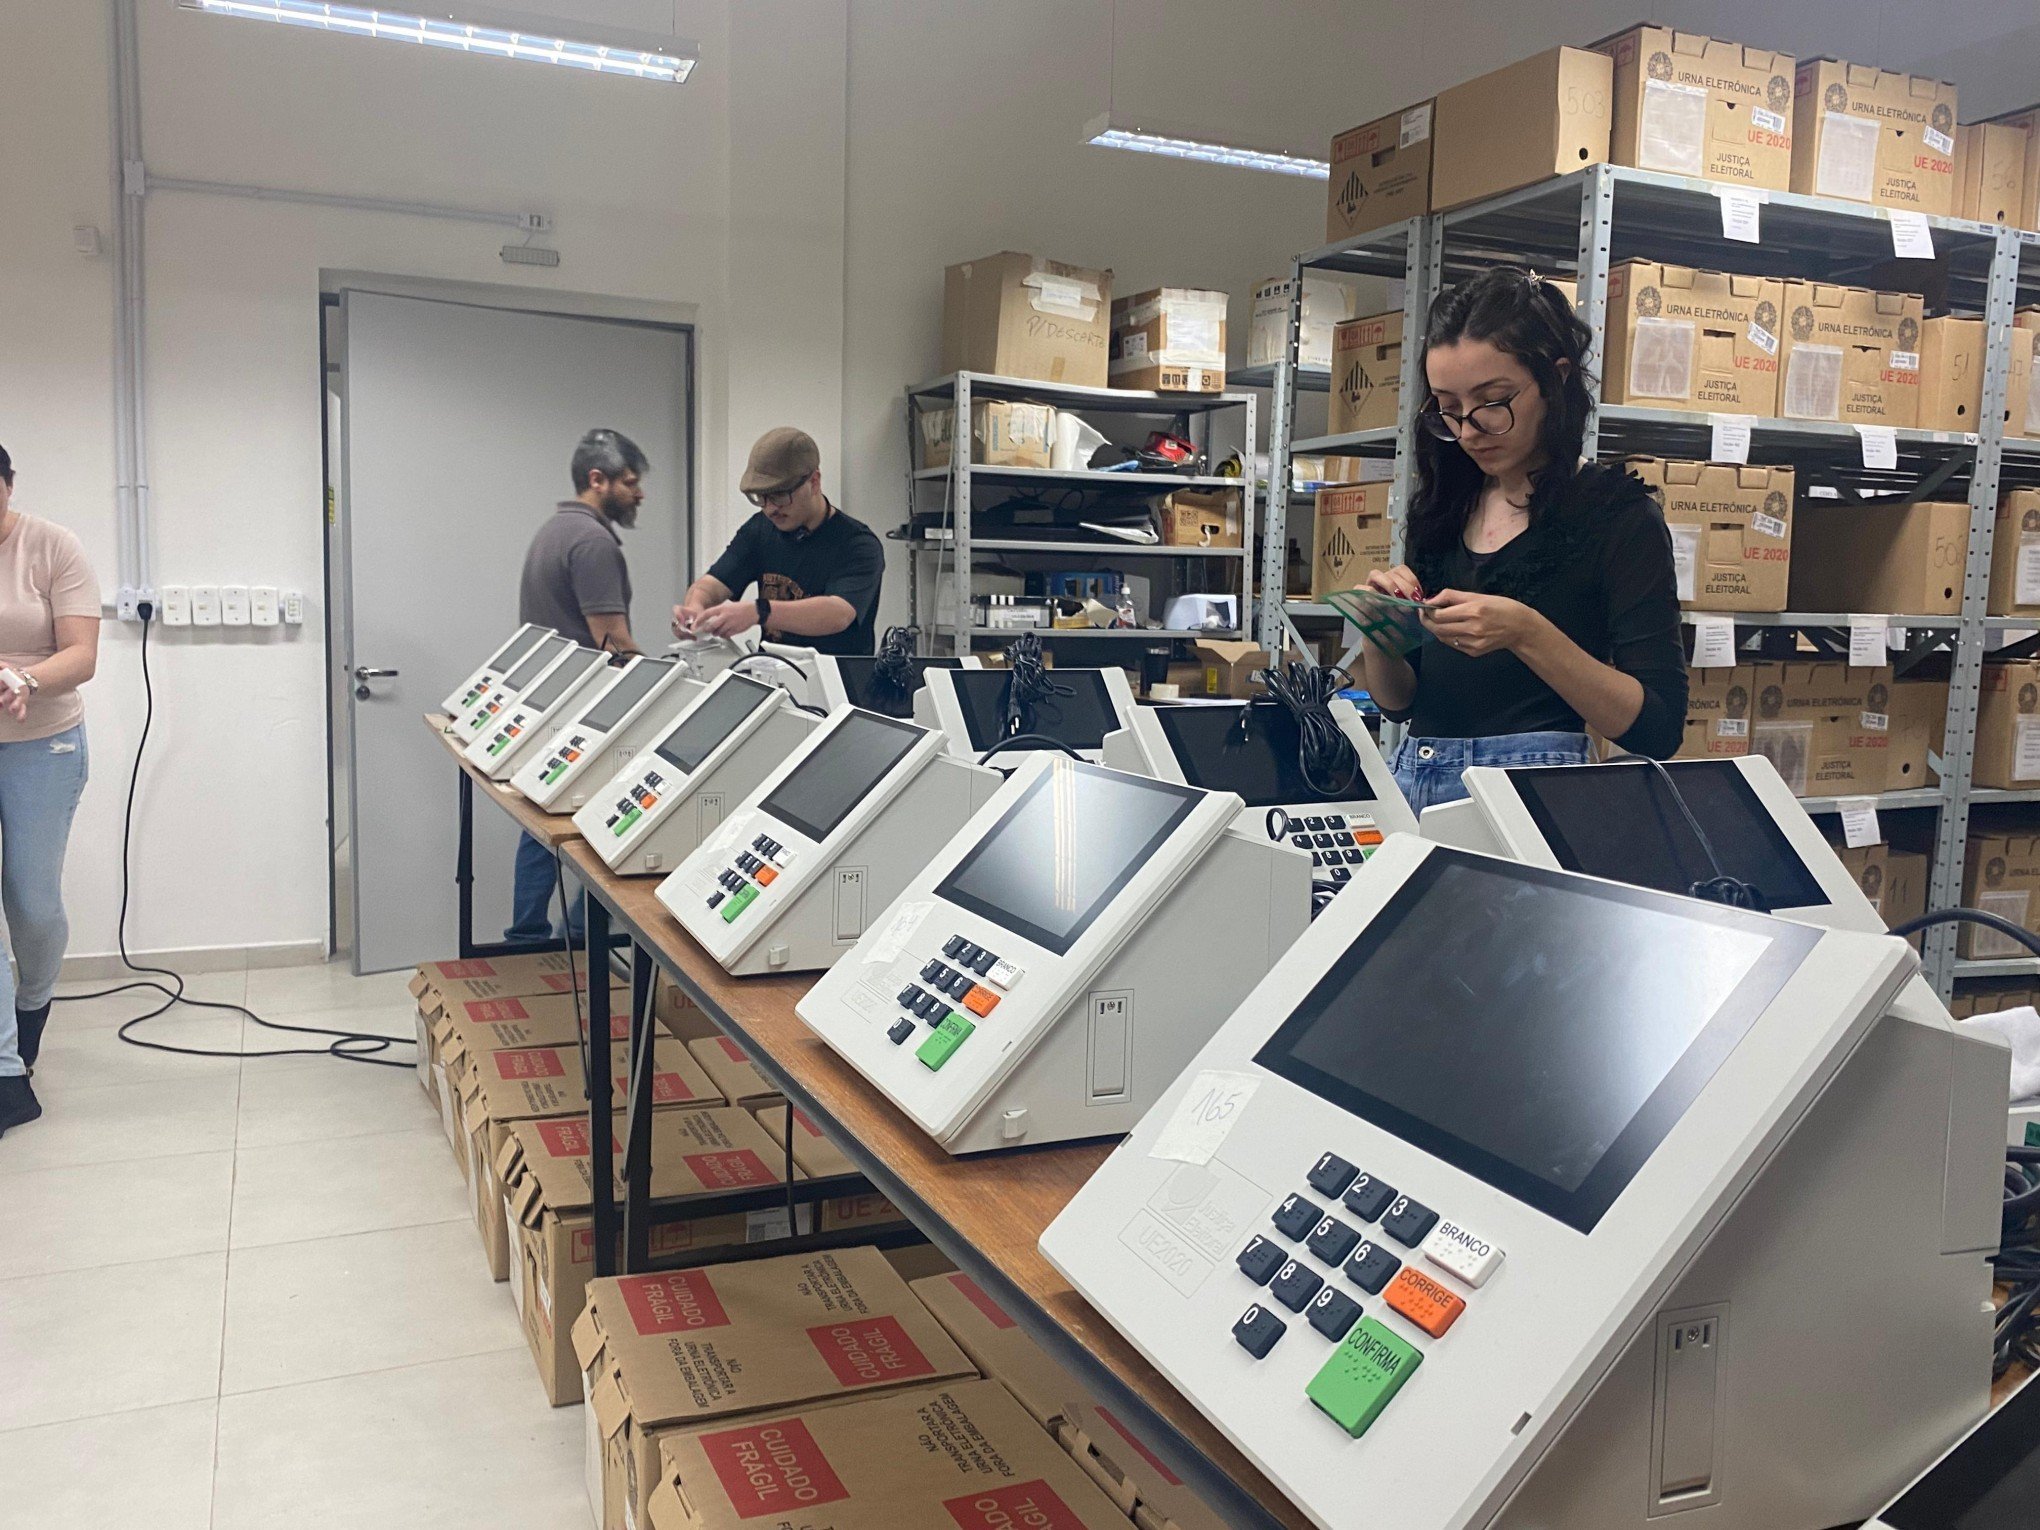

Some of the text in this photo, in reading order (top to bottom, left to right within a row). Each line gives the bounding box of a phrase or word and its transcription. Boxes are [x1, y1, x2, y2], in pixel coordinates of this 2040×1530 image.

[1678, 72, 1762, 96] URNA ELETRÔNICA
[1852, 102, 1926, 123] URNA ELETRÔNICA
[1748, 130, 1791, 150] UE 2020
[1717, 152, 1750, 166] JUSTIÇA
[1914, 156, 1952, 174] UE 2020
[1710, 163, 1754, 179] ELEITORAL
[1886, 178, 1917, 190] JUSTIÇA
[1880, 188, 1920, 202] ELEITORAL
[1667, 304, 1748, 322] URNA ELETRÔNICA
[1819, 322, 1893, 339] URNA ELETRÔNICA
[1735, 356, 1777, 372] UE 2020
[1704, 380, 1737, 391] JUSTIÇA
[1880, 370, 1919, 385] UE 2020
[1698, 391, 1741, 403] ELEITORAL
[1852, 393, 1882, 404] JUSTIÇA
[1846, 404, 1886, 415] ELEITORAL
[1671, 501, 1757, 513] URNA ELETRÔNICA
[1744, 547, 1789, 561] UE 2020
[1712, 573, 1746, 584] JUSTIÇA
[1706, 584, 1751, 594] ELEITORAL
[1688, 699, 1721, 710] RÔNICA
[1708, 740, 1748, 753] UE 2020
[1850, 736, 1888, 748] UE 2020
[1821, 760, 1852, 771] JUSTIÇA
[1816, 771, 1855, 781] ELEITORAL
[948, 936, 956, 946] 1
[961, 943, 971, 953] 2
[977, 951, 986, 961] 3
[940, 968, 949, 978] 5
[954, 977, 963, 987] 6
[930, 1003, 939, 1012] 9
[893, 1019, 902, 1028] 0
[1319, 1155, 1490, 1257] 1 2 3 BRANCO
[1283, 1197, 1453, 1308] 4 5 6 CORRIGE
[1247, 1237, 1333, 1307] 7 8 9
[642, 1283, 675, 1325] FRÁGIL
[667, 1276, 706, 1326] CUIDADO
[863, 1327, 906, 1370] FRÁGIL
[1243, 1307, 1401, 1376] 0 CONFIRMA
[831, 1327, 880, 1379] CUIDADO
[939, 1393, 984, 1441] EMBALAGEM
[919, 1434, 939, 1452] NÃO
[922, 1414, 972, 1473] TRANSPORTAR
[979, 1441, 995, 1453] DA
[760, 1429, 818, 1500] CUIDADO
[968, 1450, 993, 1474] URNA
[990, 1454, 1015, 1477] FORA
[731, 1441, 779, 1501] FRÁGIL
